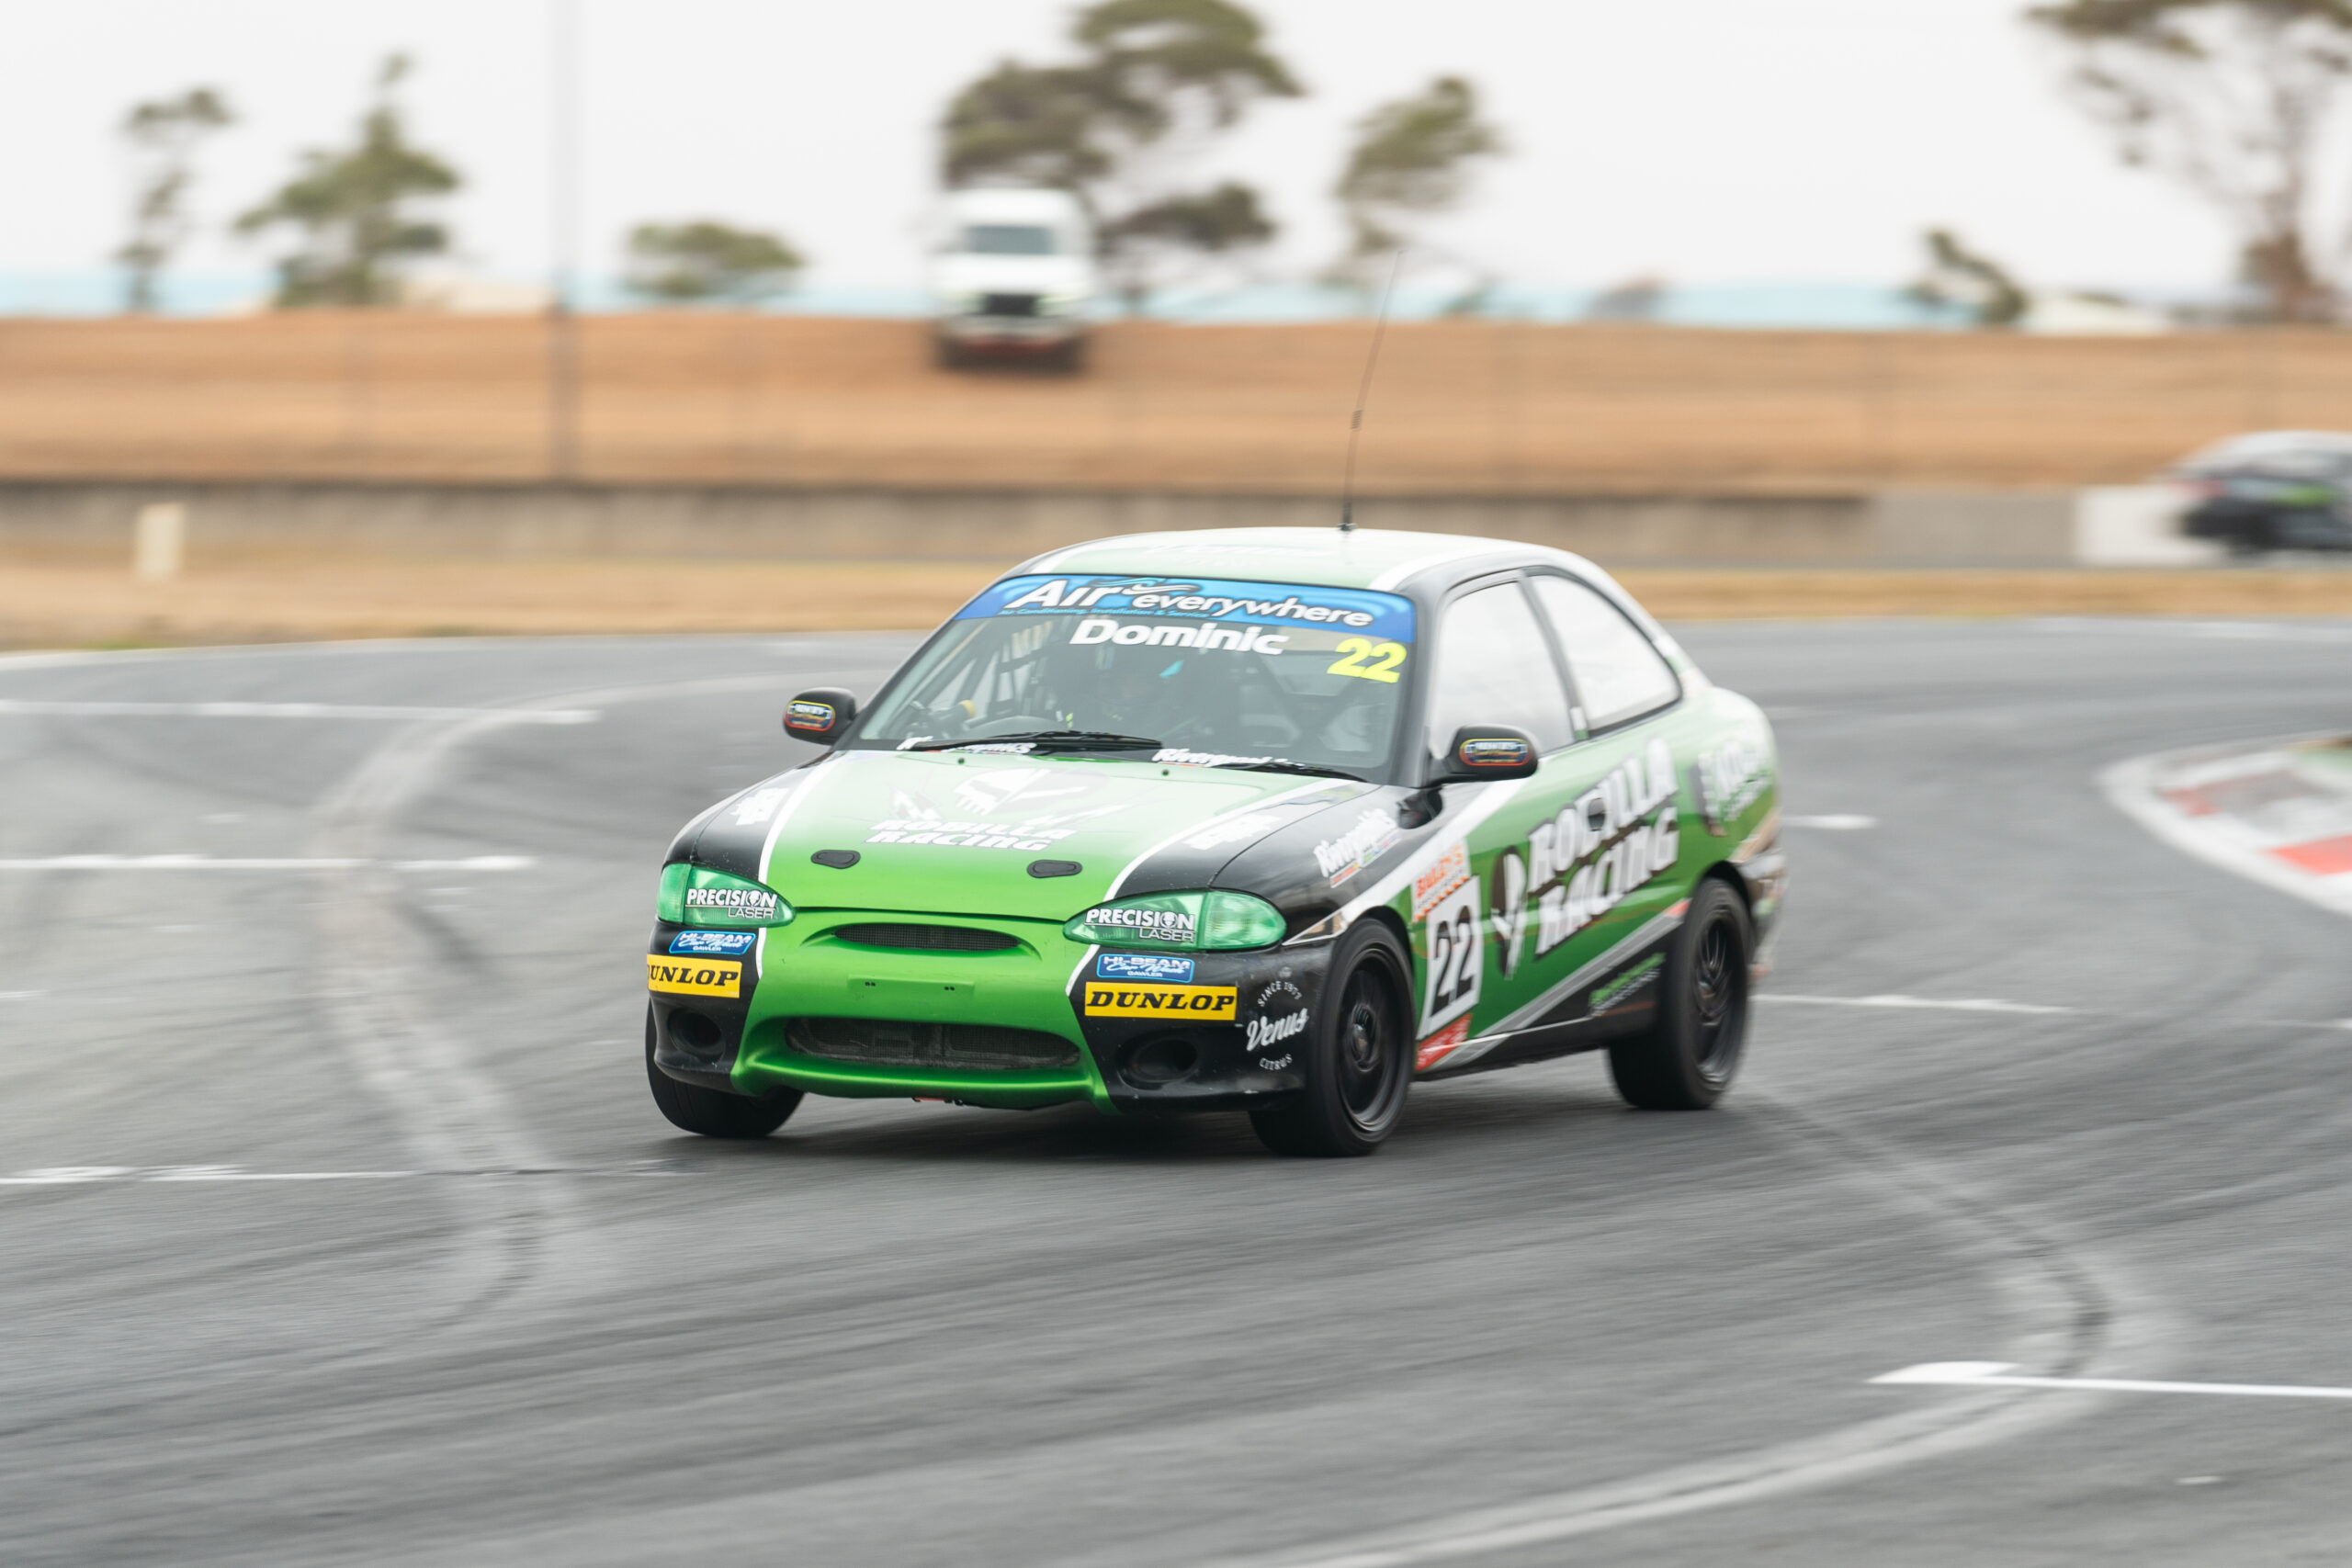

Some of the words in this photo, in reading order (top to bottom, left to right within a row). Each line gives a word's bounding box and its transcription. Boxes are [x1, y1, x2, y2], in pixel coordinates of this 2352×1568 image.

[1003, 579, 1124, 610] Air
[1130, 592, 1374, 628] everywhere
[1069, 618, 1290, 656] Dominic
[1327, 637, 1408, 683] 22
[864, 829, 1053, 852] RACING
[1535, 806, 1680, 955] RACING
[687, 888, 778, 908] PRECISION
[728, 908, 775, 919] LASER
[1085, 908, 1195, 930] PRECISION
[679, 932, 752, 943] HI-BEAM
[1138, 928, 1195, 942] LASER
[1103, 956, 1192, 969] HI-BEAM
[1430, 905, 1475, 1017] 22
[647, 964, 739, 987] UNLOP
[1086, 991, 1235, 1011] DUNLOP
[1257, 980, 1282, 1007] SINCE
[1246, 1008, 1310, 1051] Venus
